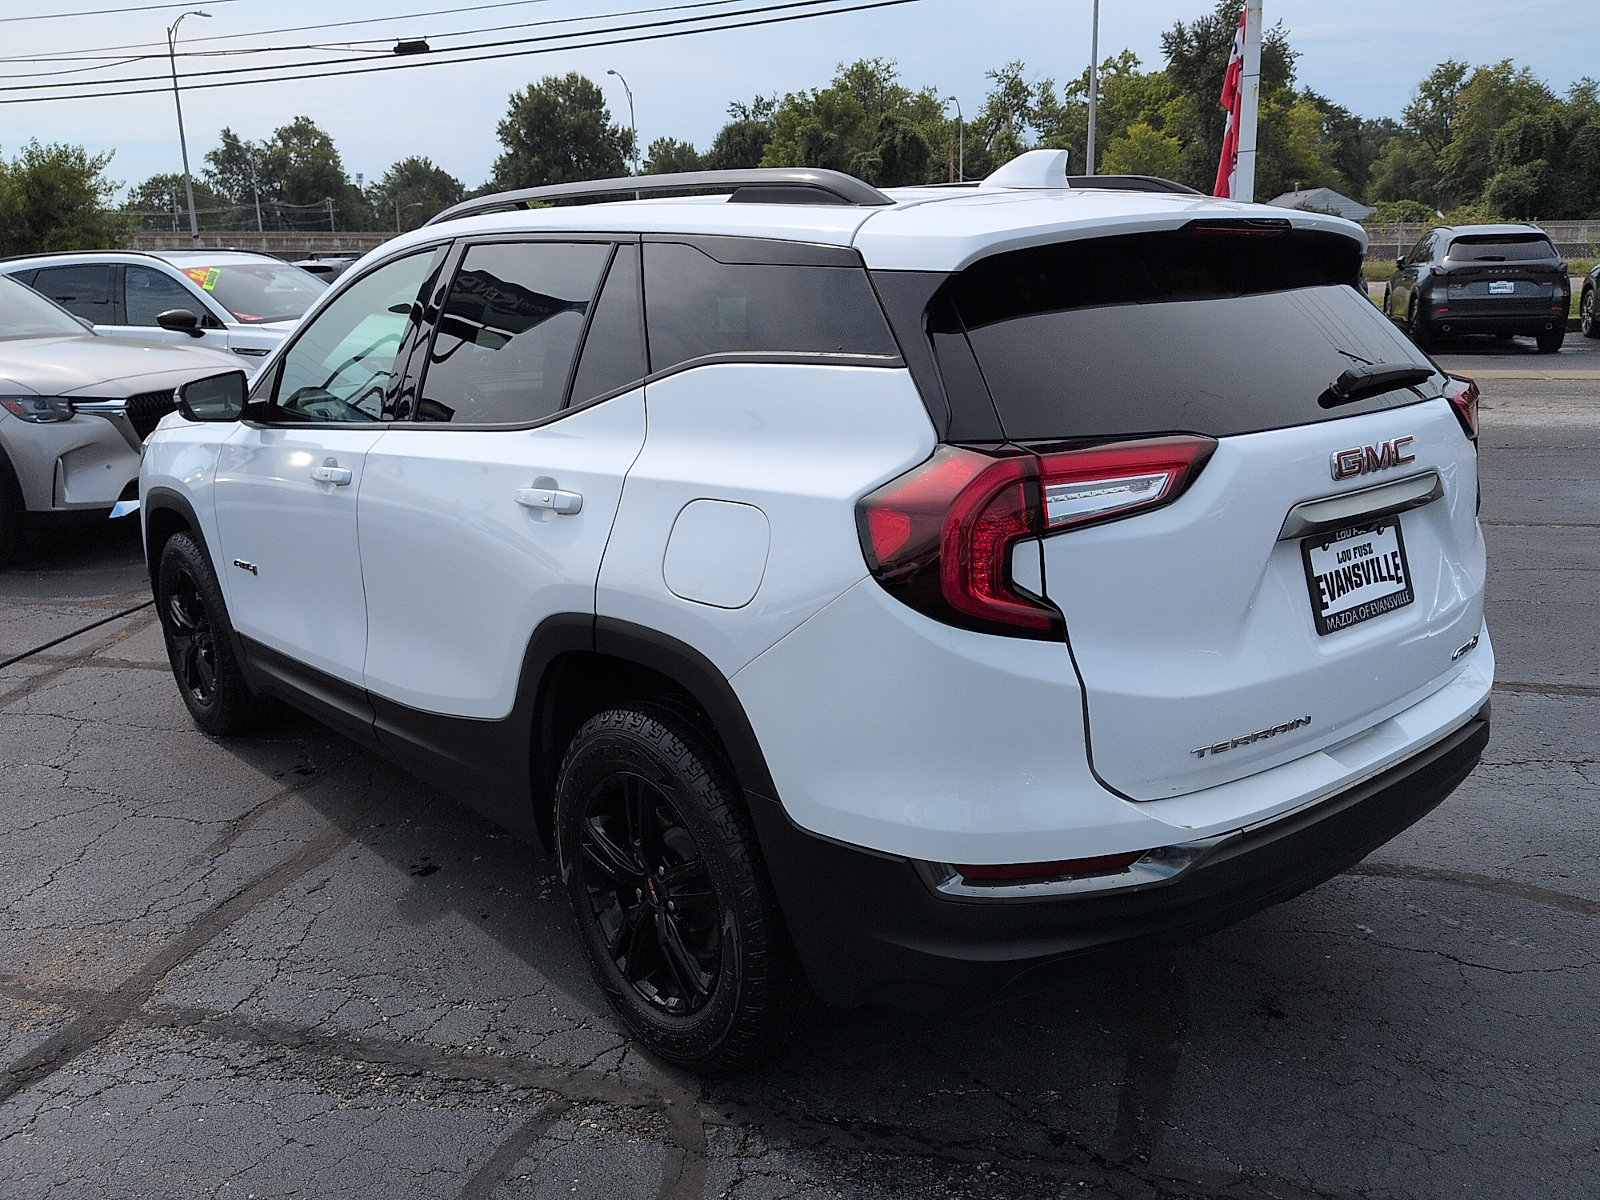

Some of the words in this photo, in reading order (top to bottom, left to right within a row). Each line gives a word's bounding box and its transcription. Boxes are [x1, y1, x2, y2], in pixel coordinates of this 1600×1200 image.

[1330, 435, 1416, 480] GMC
[1336, 549, 1351, 564] LOU
[1353, 542, 1373, 559] FUSZ
[1314, 551, 1403, 611] EVANSVILLE
[1326, 610, 1358, 630] MAZDA
[1359, 606, 1370, 618] OF
[1370, 591, 1411, 614] EVANSVILLE
[1190, 715, 1311, 758] TERRAIN
